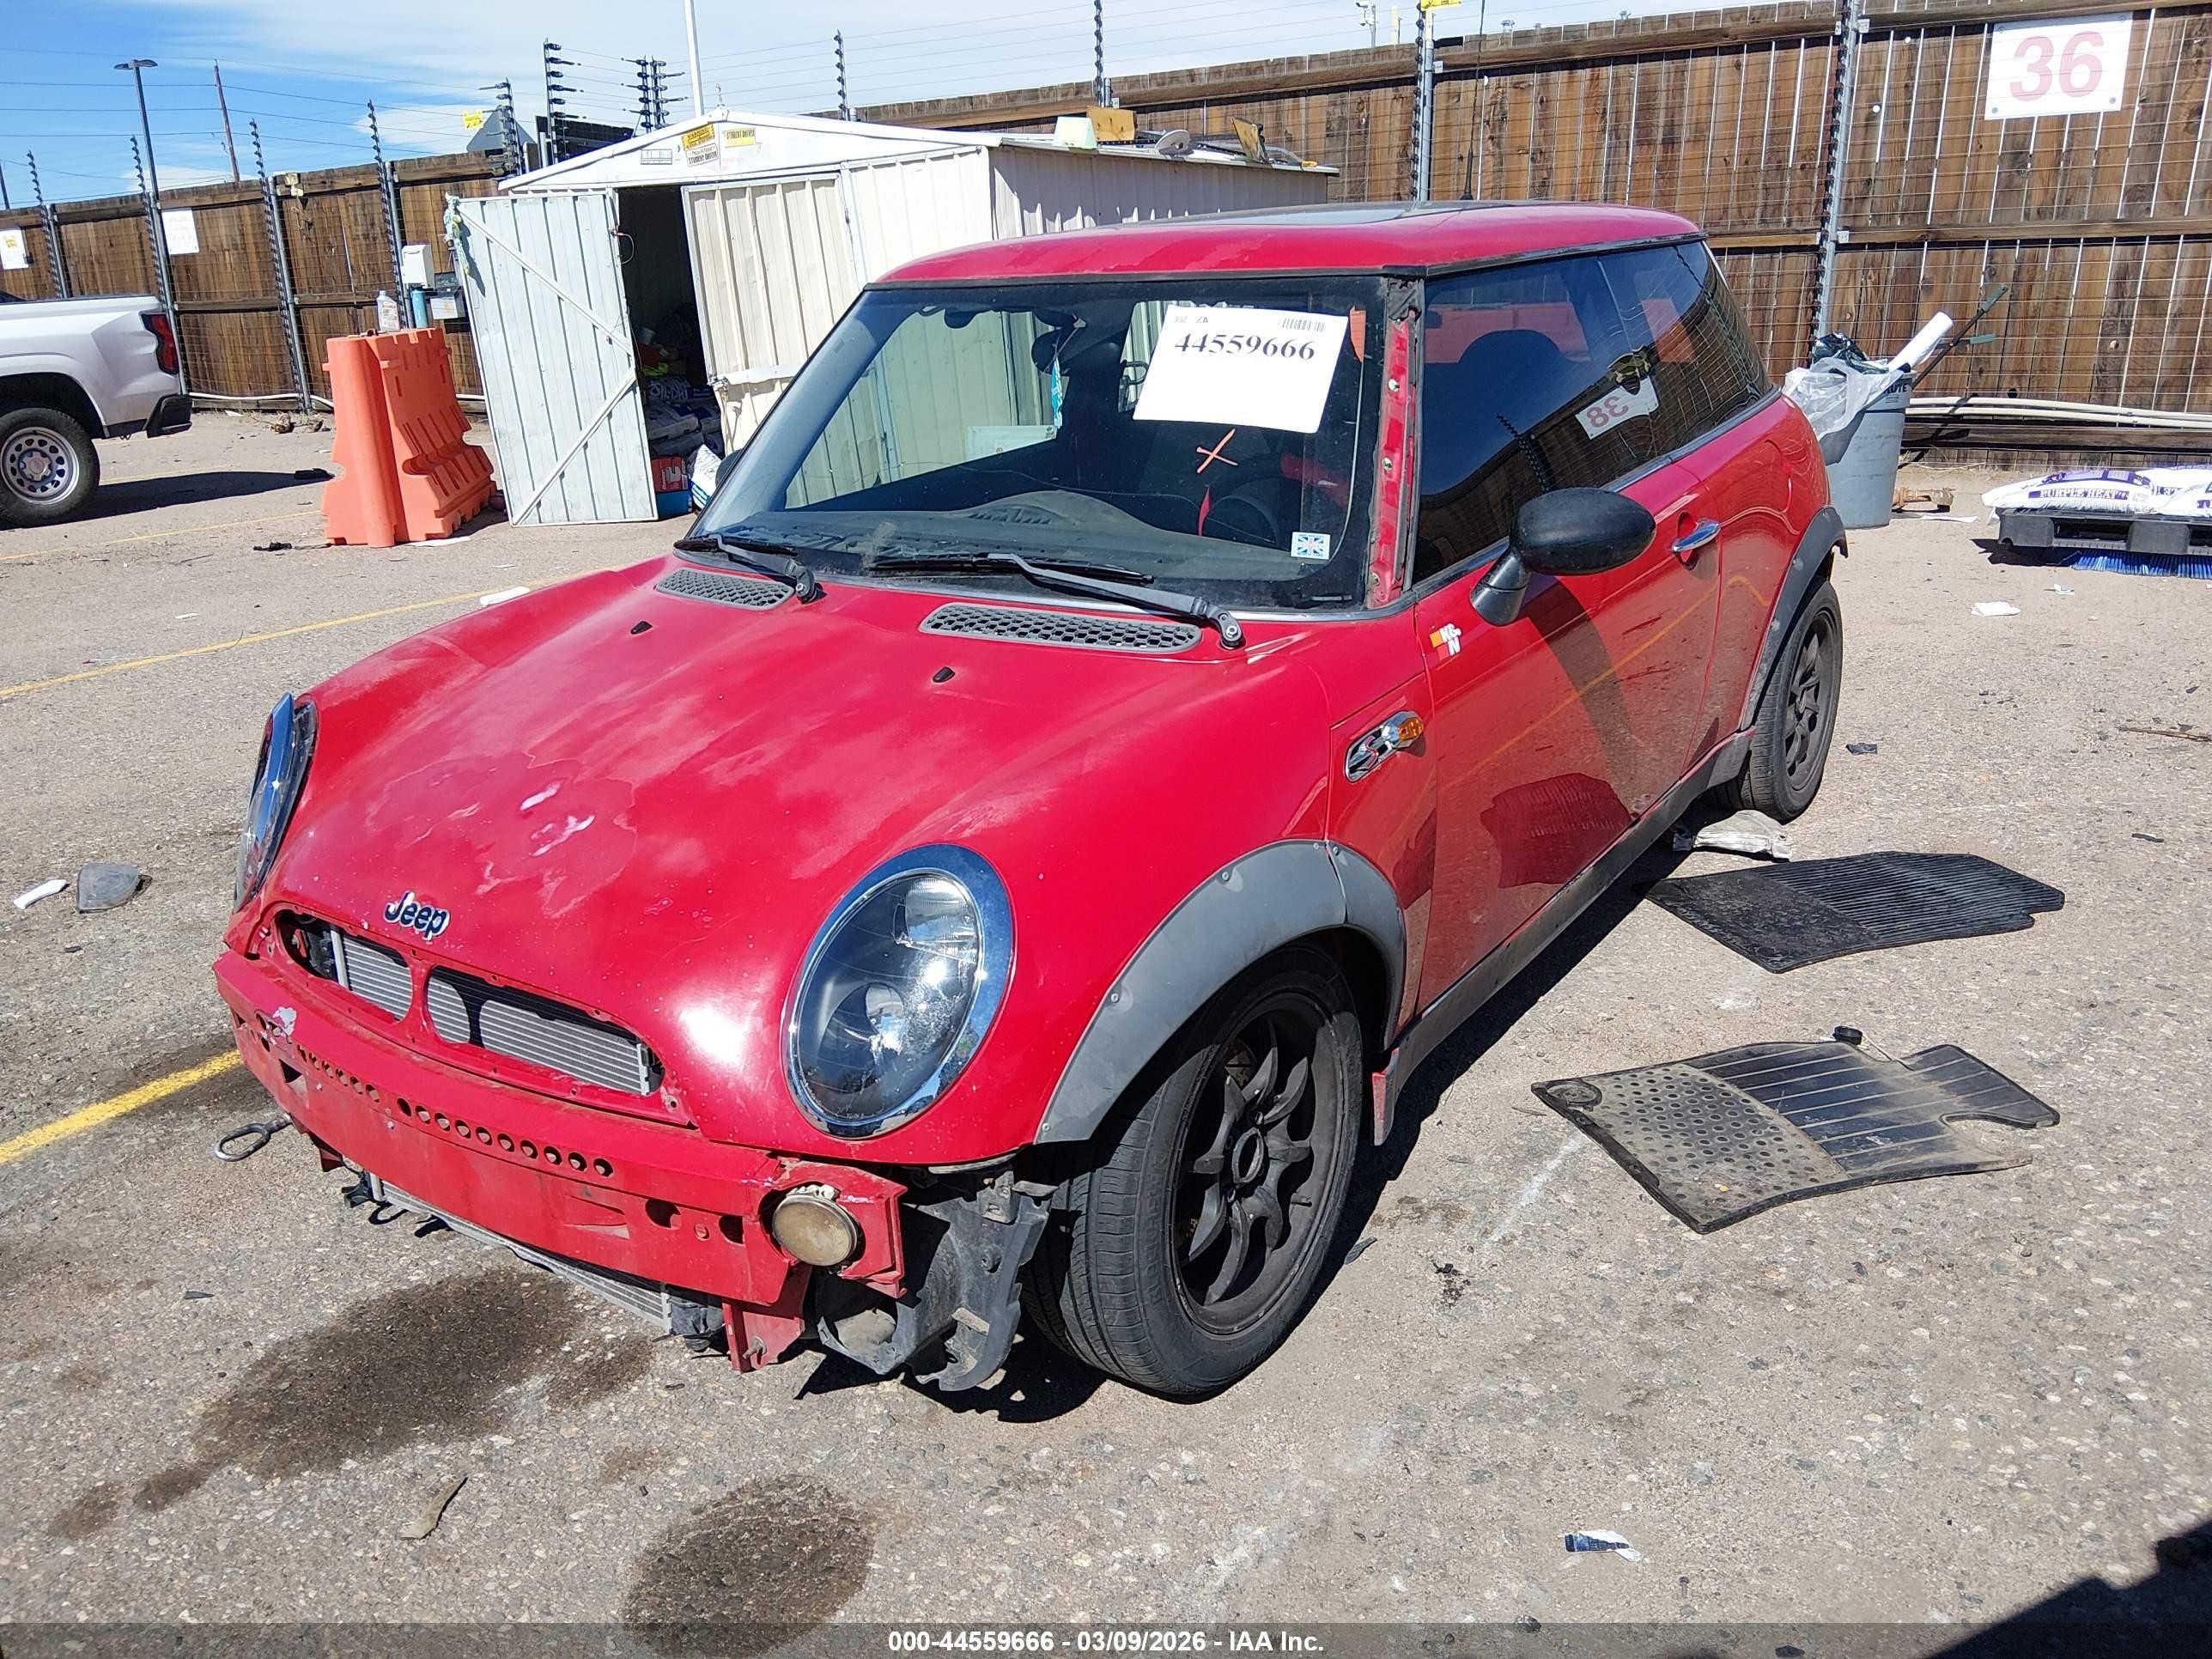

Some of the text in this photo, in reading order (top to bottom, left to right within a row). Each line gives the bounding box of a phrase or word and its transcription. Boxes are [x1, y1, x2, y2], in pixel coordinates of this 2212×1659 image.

[2009, 30, 2104, 101] 36
[1174, 333, 1316, 361] 44559666
[383, 890, 451, 941] Jeep
